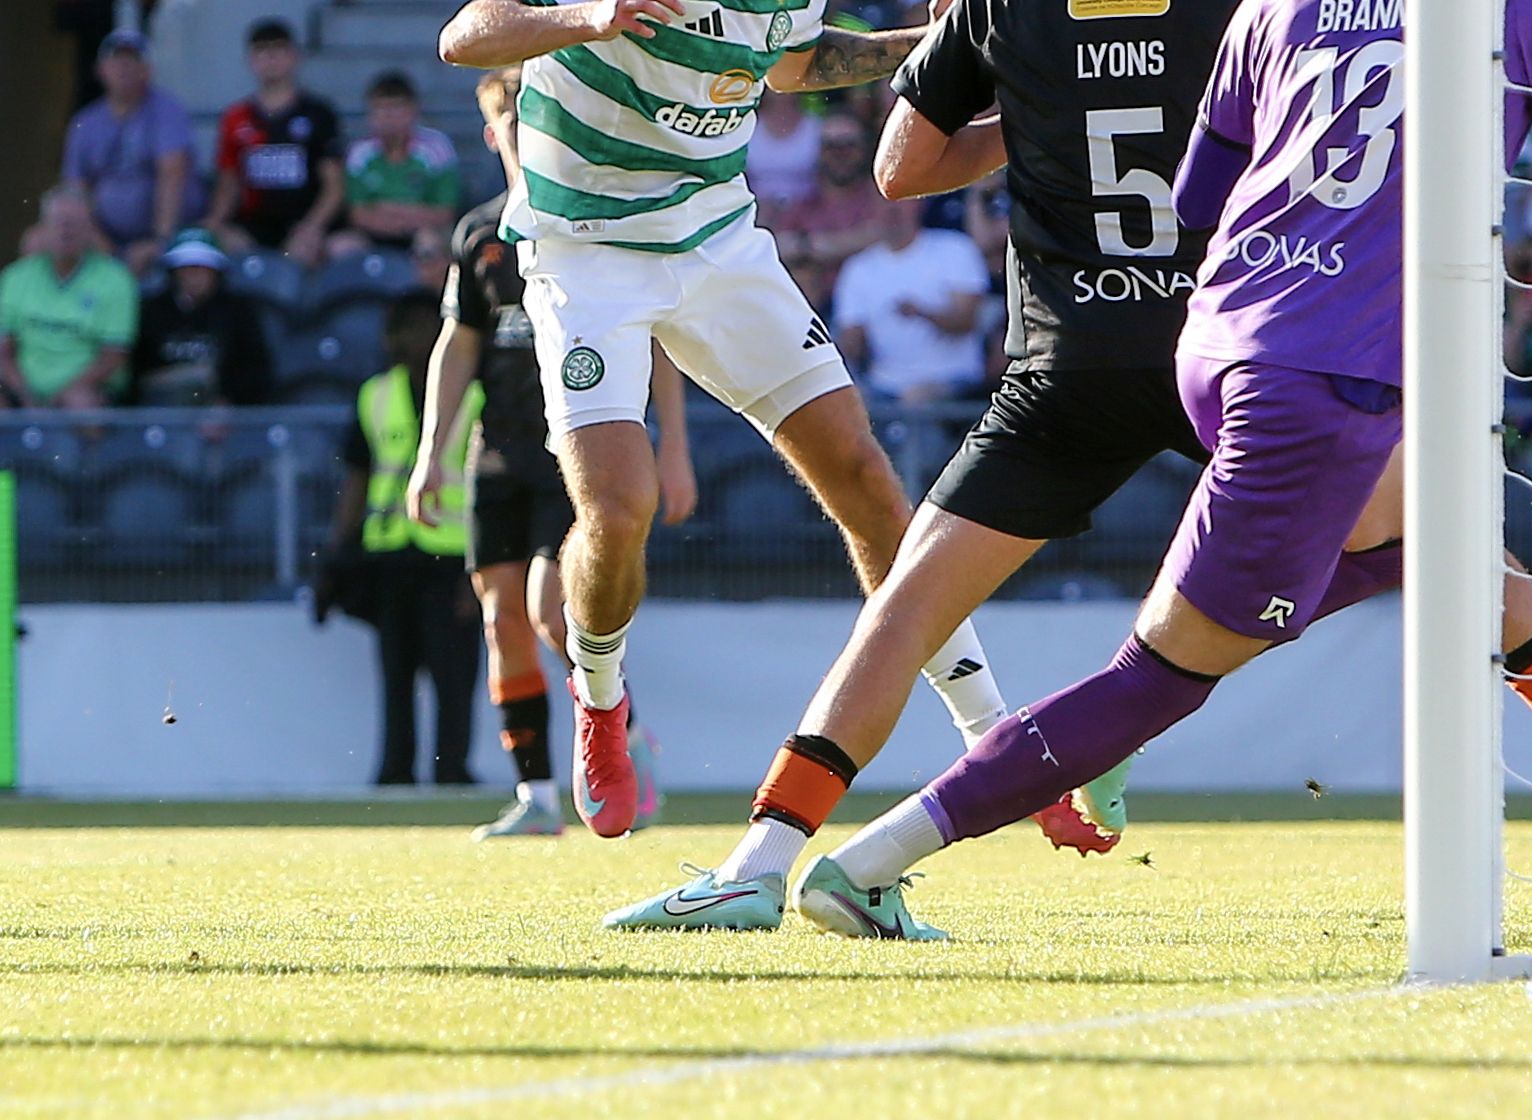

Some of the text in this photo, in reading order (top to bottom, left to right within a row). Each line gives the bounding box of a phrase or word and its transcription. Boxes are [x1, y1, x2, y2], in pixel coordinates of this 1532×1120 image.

[1076, 40, 1165, 79] LYONS
[654, 103, 743, 137] dafab
[1288, 39, 1405, 209] 13
[1085, 106, 1179, 257] 5
[1073, 266, 1196, 303] SONA
